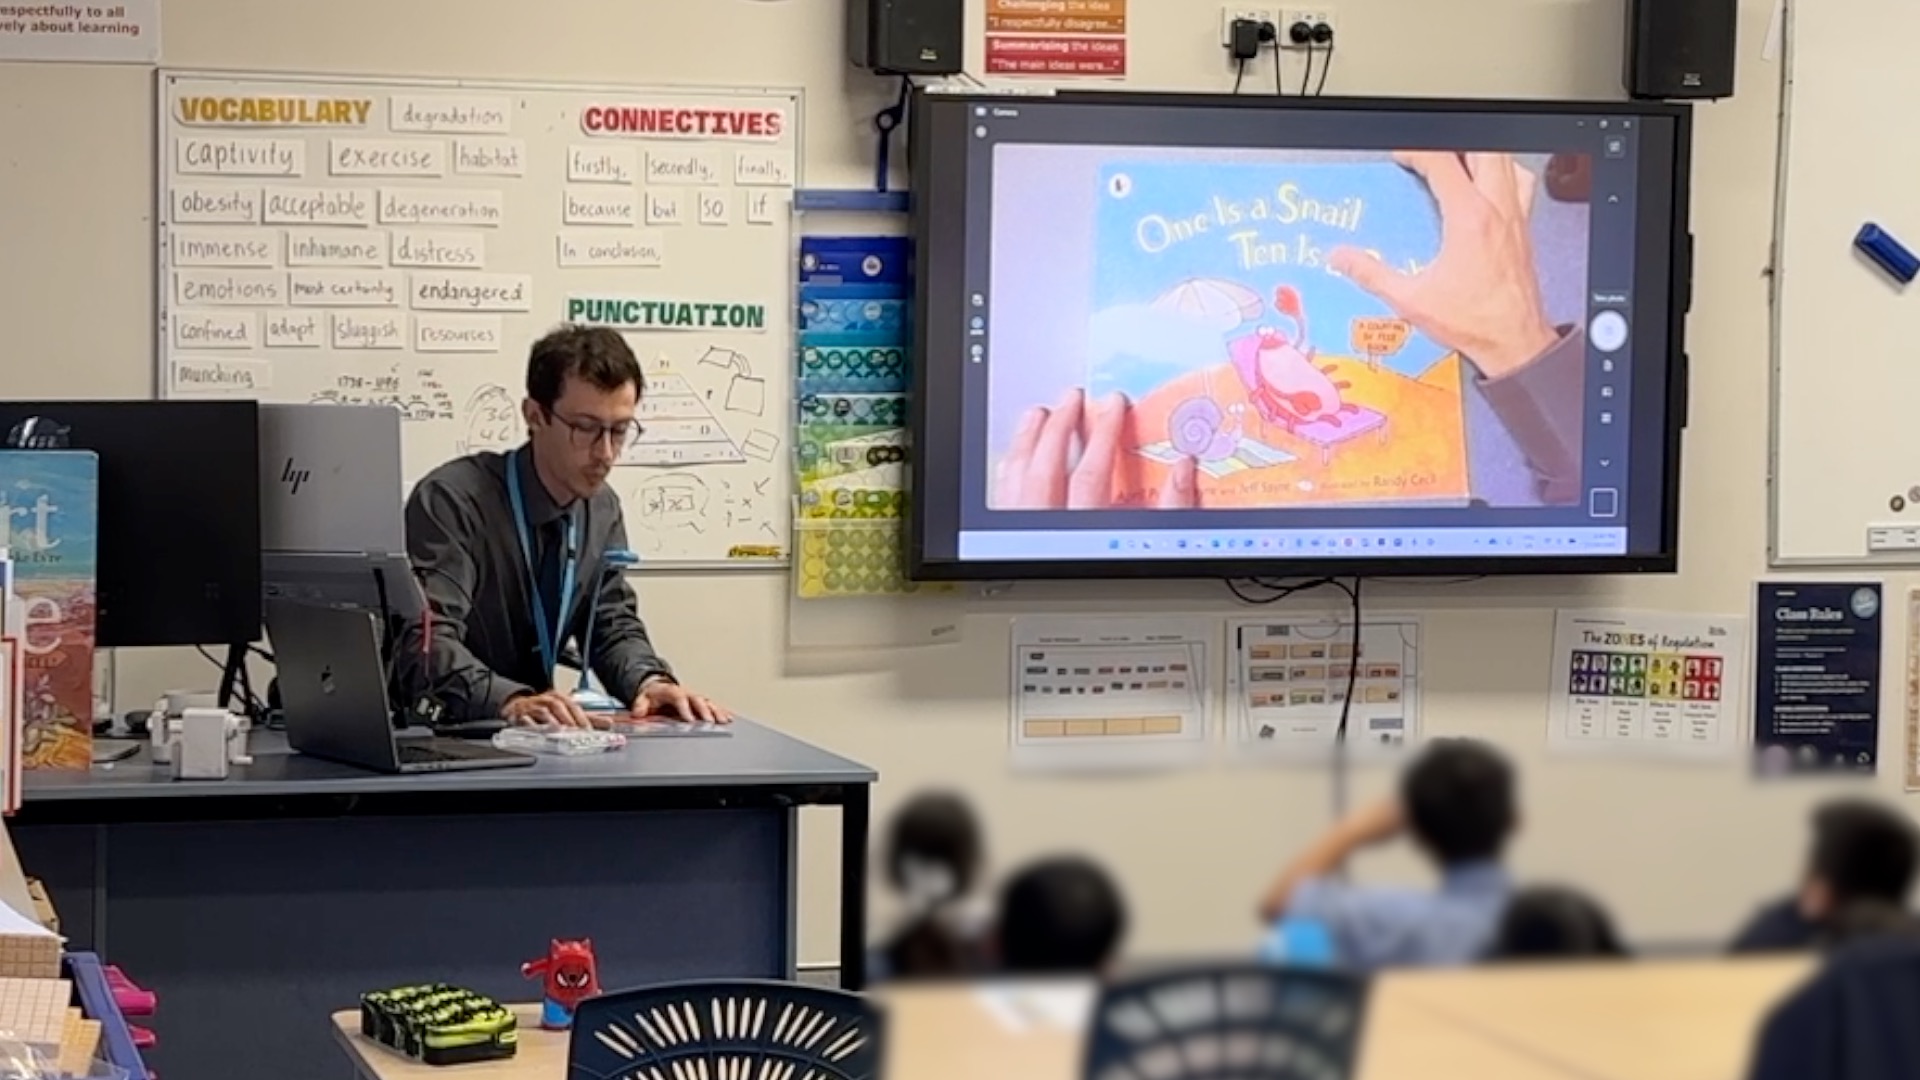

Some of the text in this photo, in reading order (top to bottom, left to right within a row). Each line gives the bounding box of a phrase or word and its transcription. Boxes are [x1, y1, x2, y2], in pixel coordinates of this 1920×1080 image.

[87, 7, 102, 17] to
[106, 6, 125, 18] all
[1067, 1, 1086, 10] the
[1087, 1, 1110, 11] idea
[30, 22, 74, 33] about
[78, 22, 140, 36] learning
[1001, 17, 1062, 31] respectfully
[992, 39, 1119, 53] Summarising the ideas
[1019, 60, 1046, 70] main
[1048, 60, 1076, 70] ideas
[180, 97, 372, 124] VOCABULARY
[403, 102, 502, 129] degradation
[584, 107, 782, 136] CONNECTIVES
[339, 146, 431, 168] exercise
[460, 145, 518, 168] habitat
[573, 151, 627, 179] firstly,
[650, 156, 714, 181] secondly,
[737, 156, 788, 181] finally,
[181, 189, 254, 219] obesity
[269, 191, 366, 220] acceptable
[384, 195, 499, 223] degeneration
[569, 195, 632, 217] because
[653, 196, 677, 218] but
[1136, 181, 1363, 253] One Is a Snail
[180, 240, 269, 259] immense
[292, 236, 379, 260] inhumane
[397, 235, 476, 262] distress
[587, 240, 662, 261] conclusion,
[1227, 229, 1287, 271] Ten
[1295, 233, 1322, 268] Is
[184, 277, 278, 300] emotions
[418, 280, 523, 306] endangered
[567, 298, 764, 328] PUNCTUATION
[180, 319, 247, 341] confined
[269, 316, 315, 342] adapt
[337, 316, 398, 346] sluggish
[421, 327, 495, 343] resources
[281, 457, 311, 495] hp
[1373, 474, 1408, 489] Randy
[1775, 606, 1843, 621] Class Rules
[1582, 631, 1715, 652] The ZONES of Regulation
